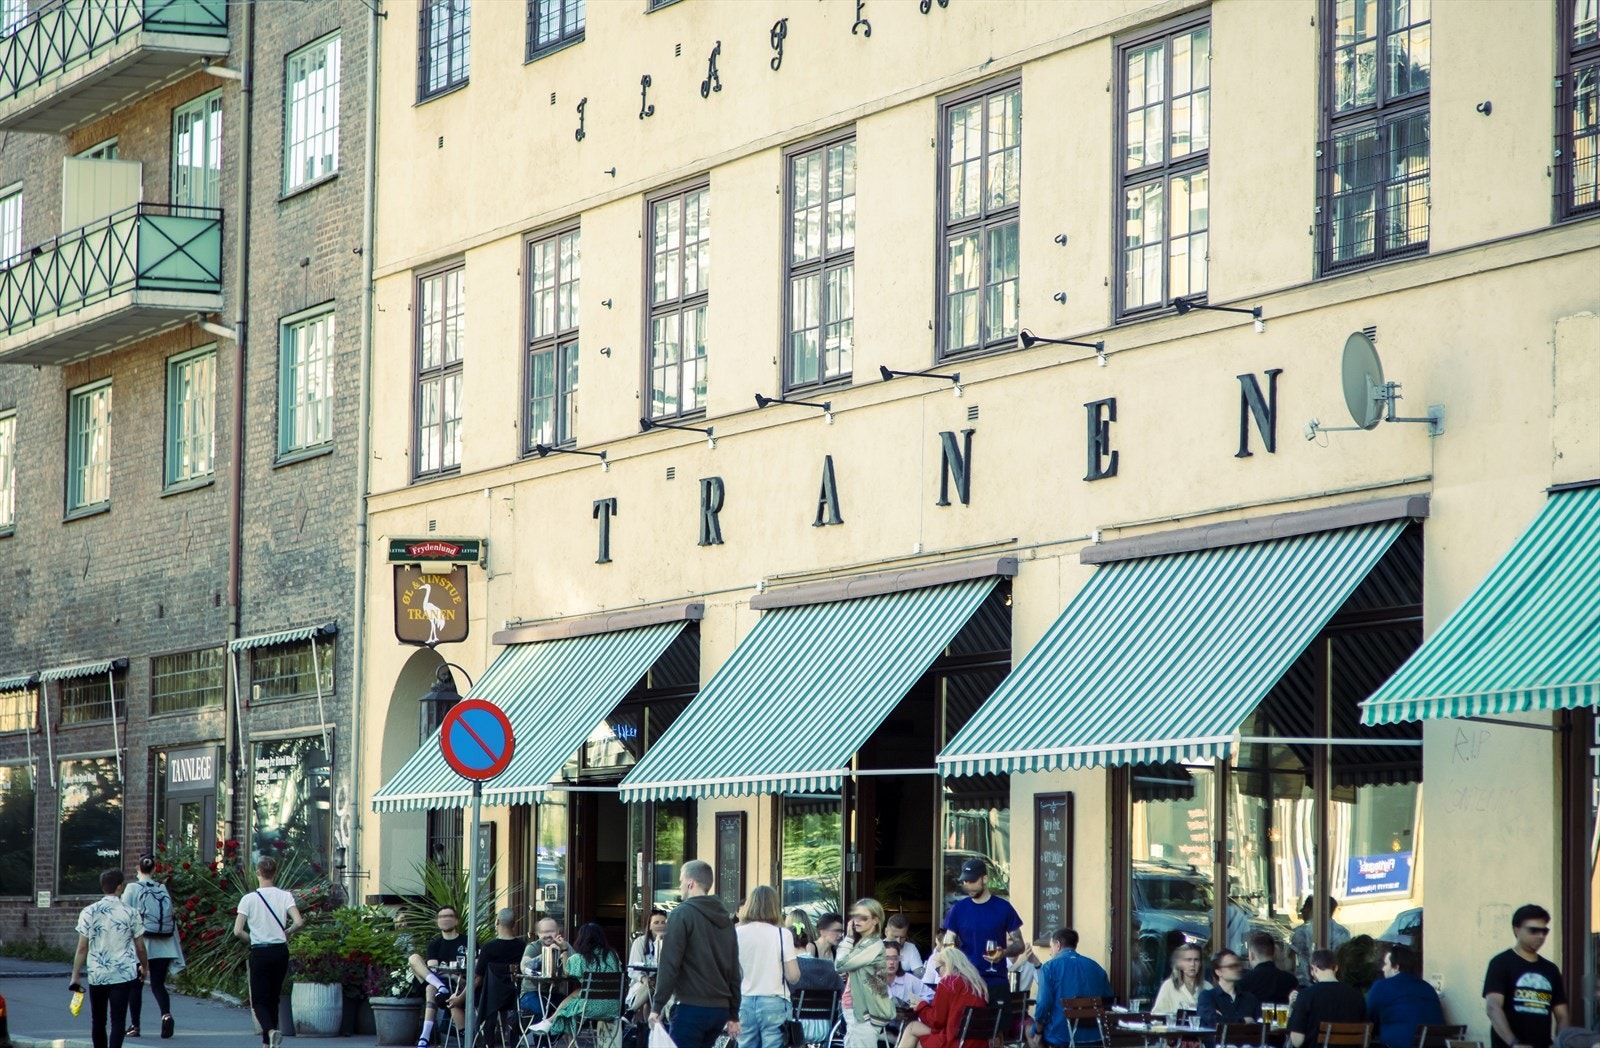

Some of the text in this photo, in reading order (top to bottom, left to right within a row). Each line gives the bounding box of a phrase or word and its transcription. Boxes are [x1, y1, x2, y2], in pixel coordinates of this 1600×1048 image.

[593, 368, 1283, 564] TRANEN
[412, 543, 457, 555] Frydenlund
[402, 574, 462, 606] ØL & VINSTUE
[407, 608, 456, 621] TRANEN
[171, 756, 212, 783] TANNLEGE
